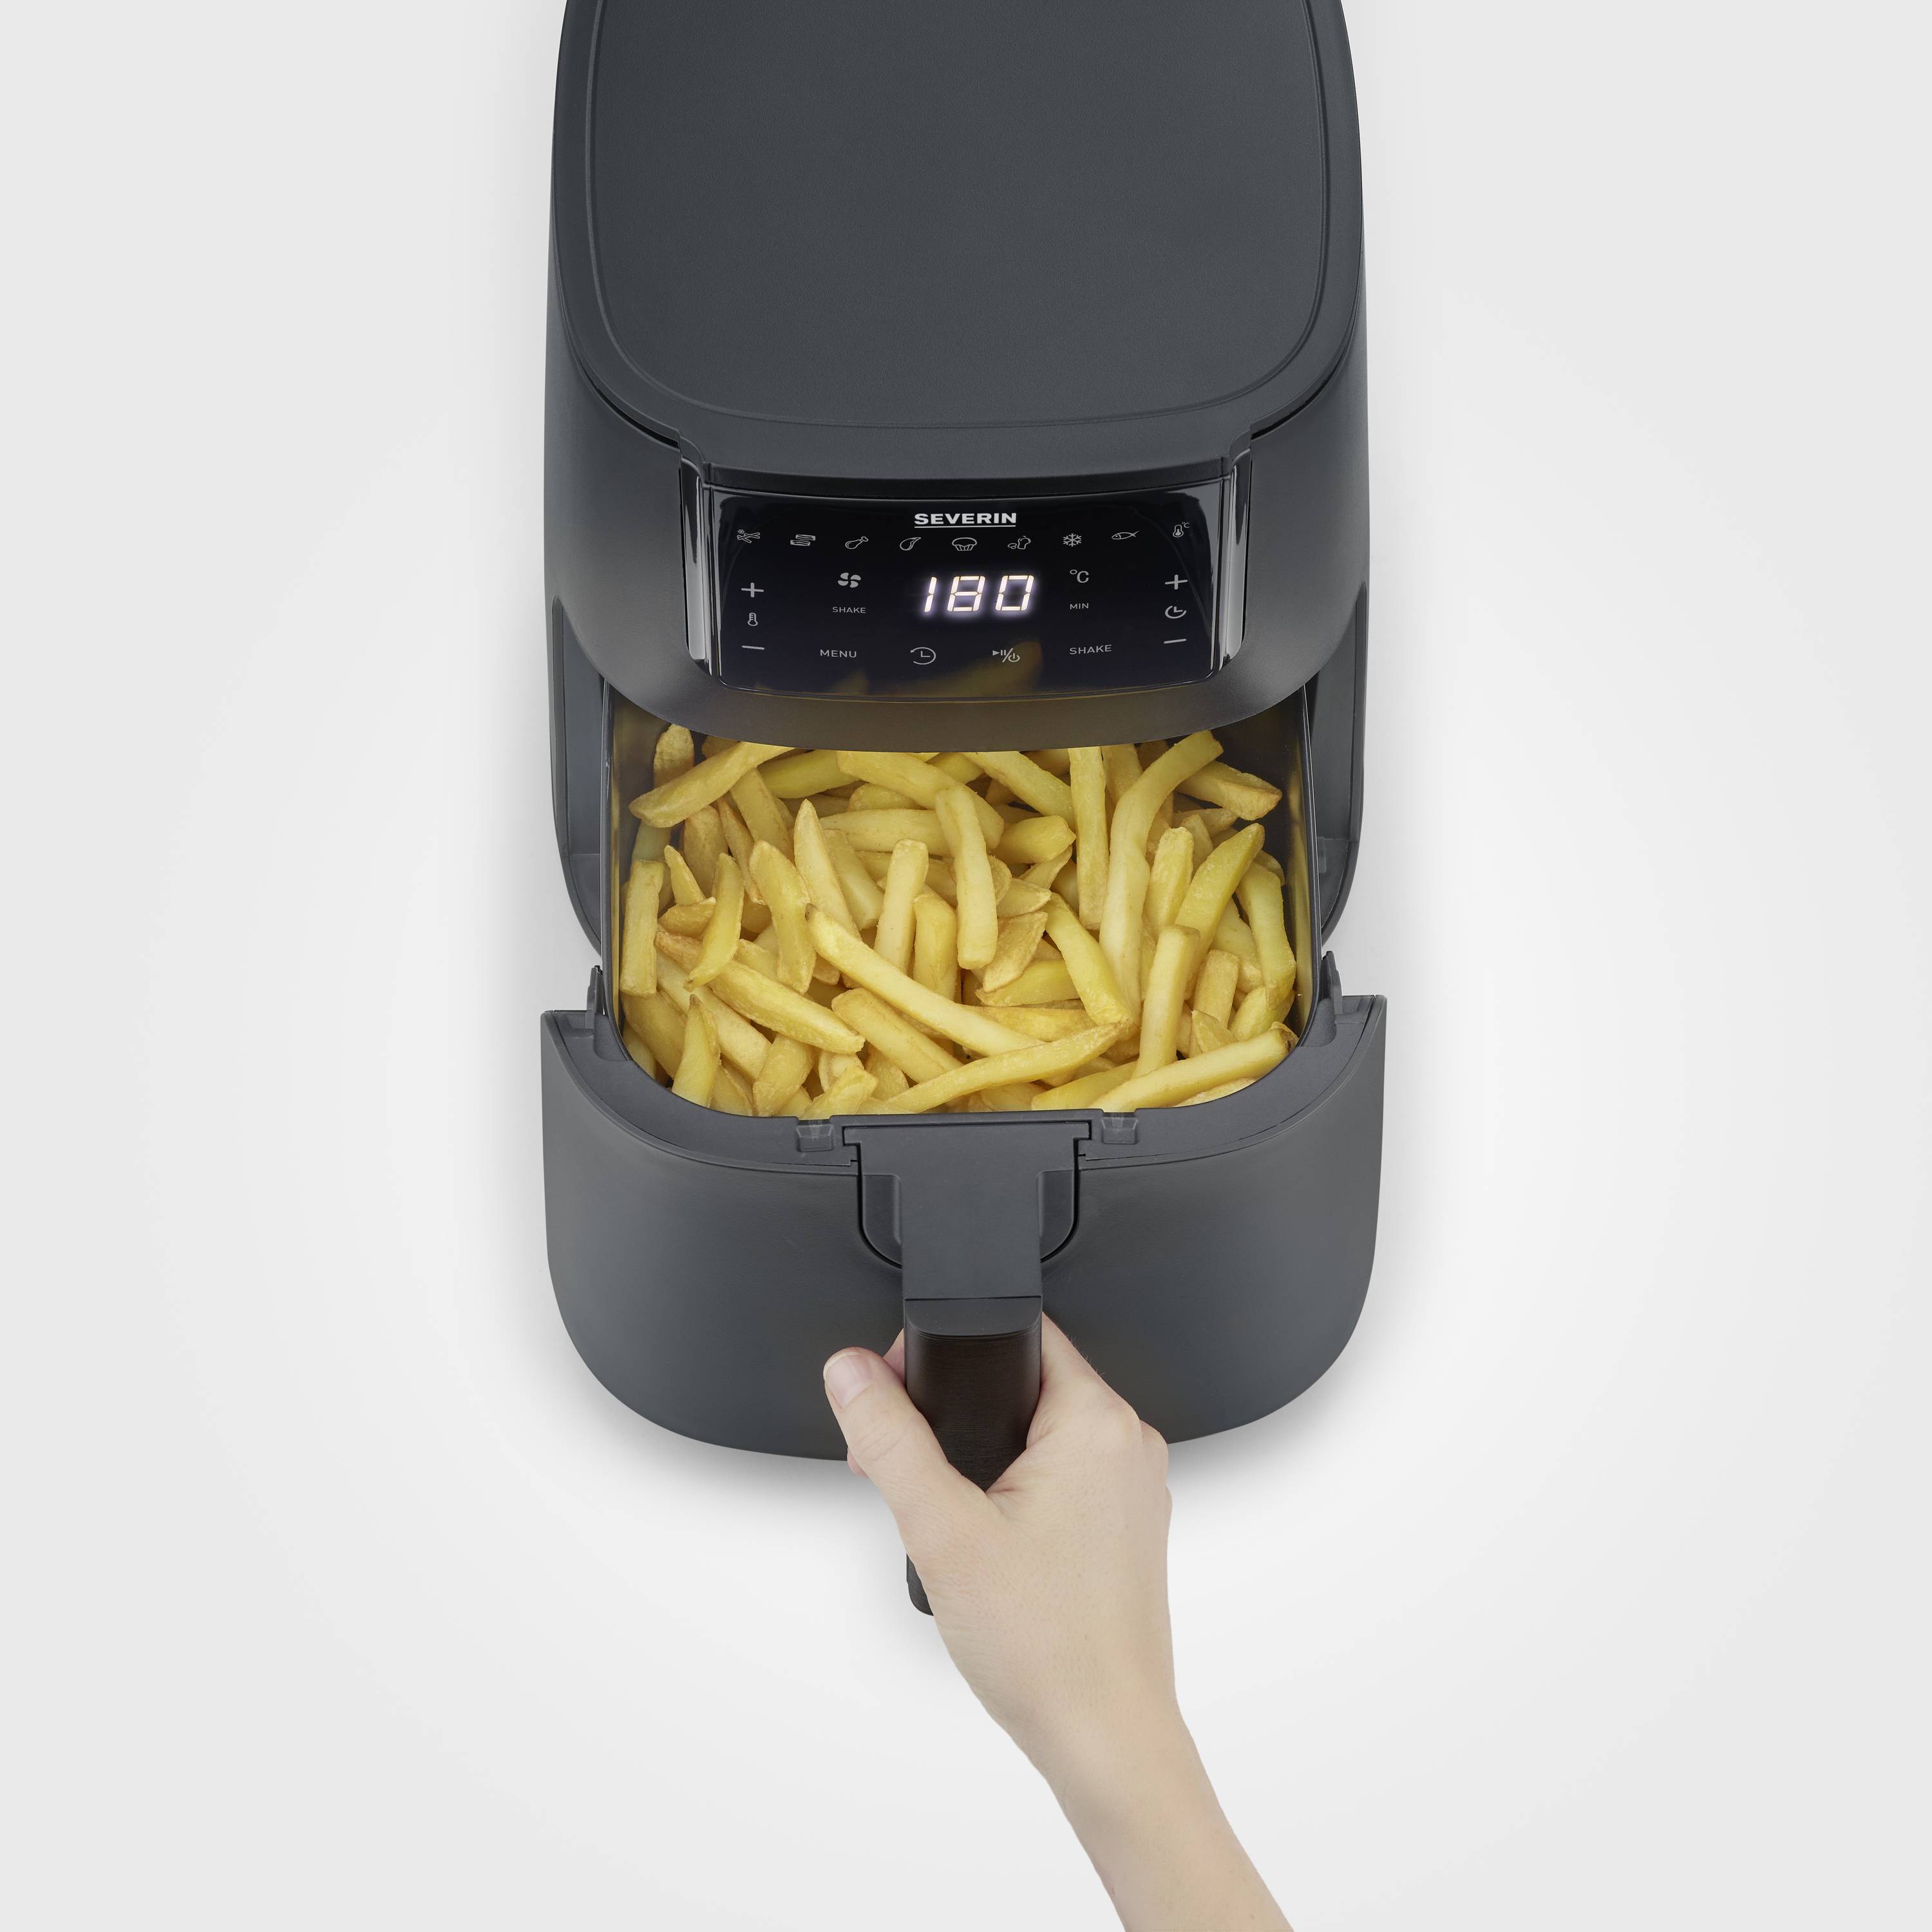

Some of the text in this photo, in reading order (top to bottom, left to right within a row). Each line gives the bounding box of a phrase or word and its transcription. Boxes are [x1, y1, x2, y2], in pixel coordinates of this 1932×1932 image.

[914, 513, 1017, 525] SEVERIN
[923, 575, 1034, 612] 180
[820, 649, 857, 658] MENU
[1069, 644, 1112, 655] SHAKE
